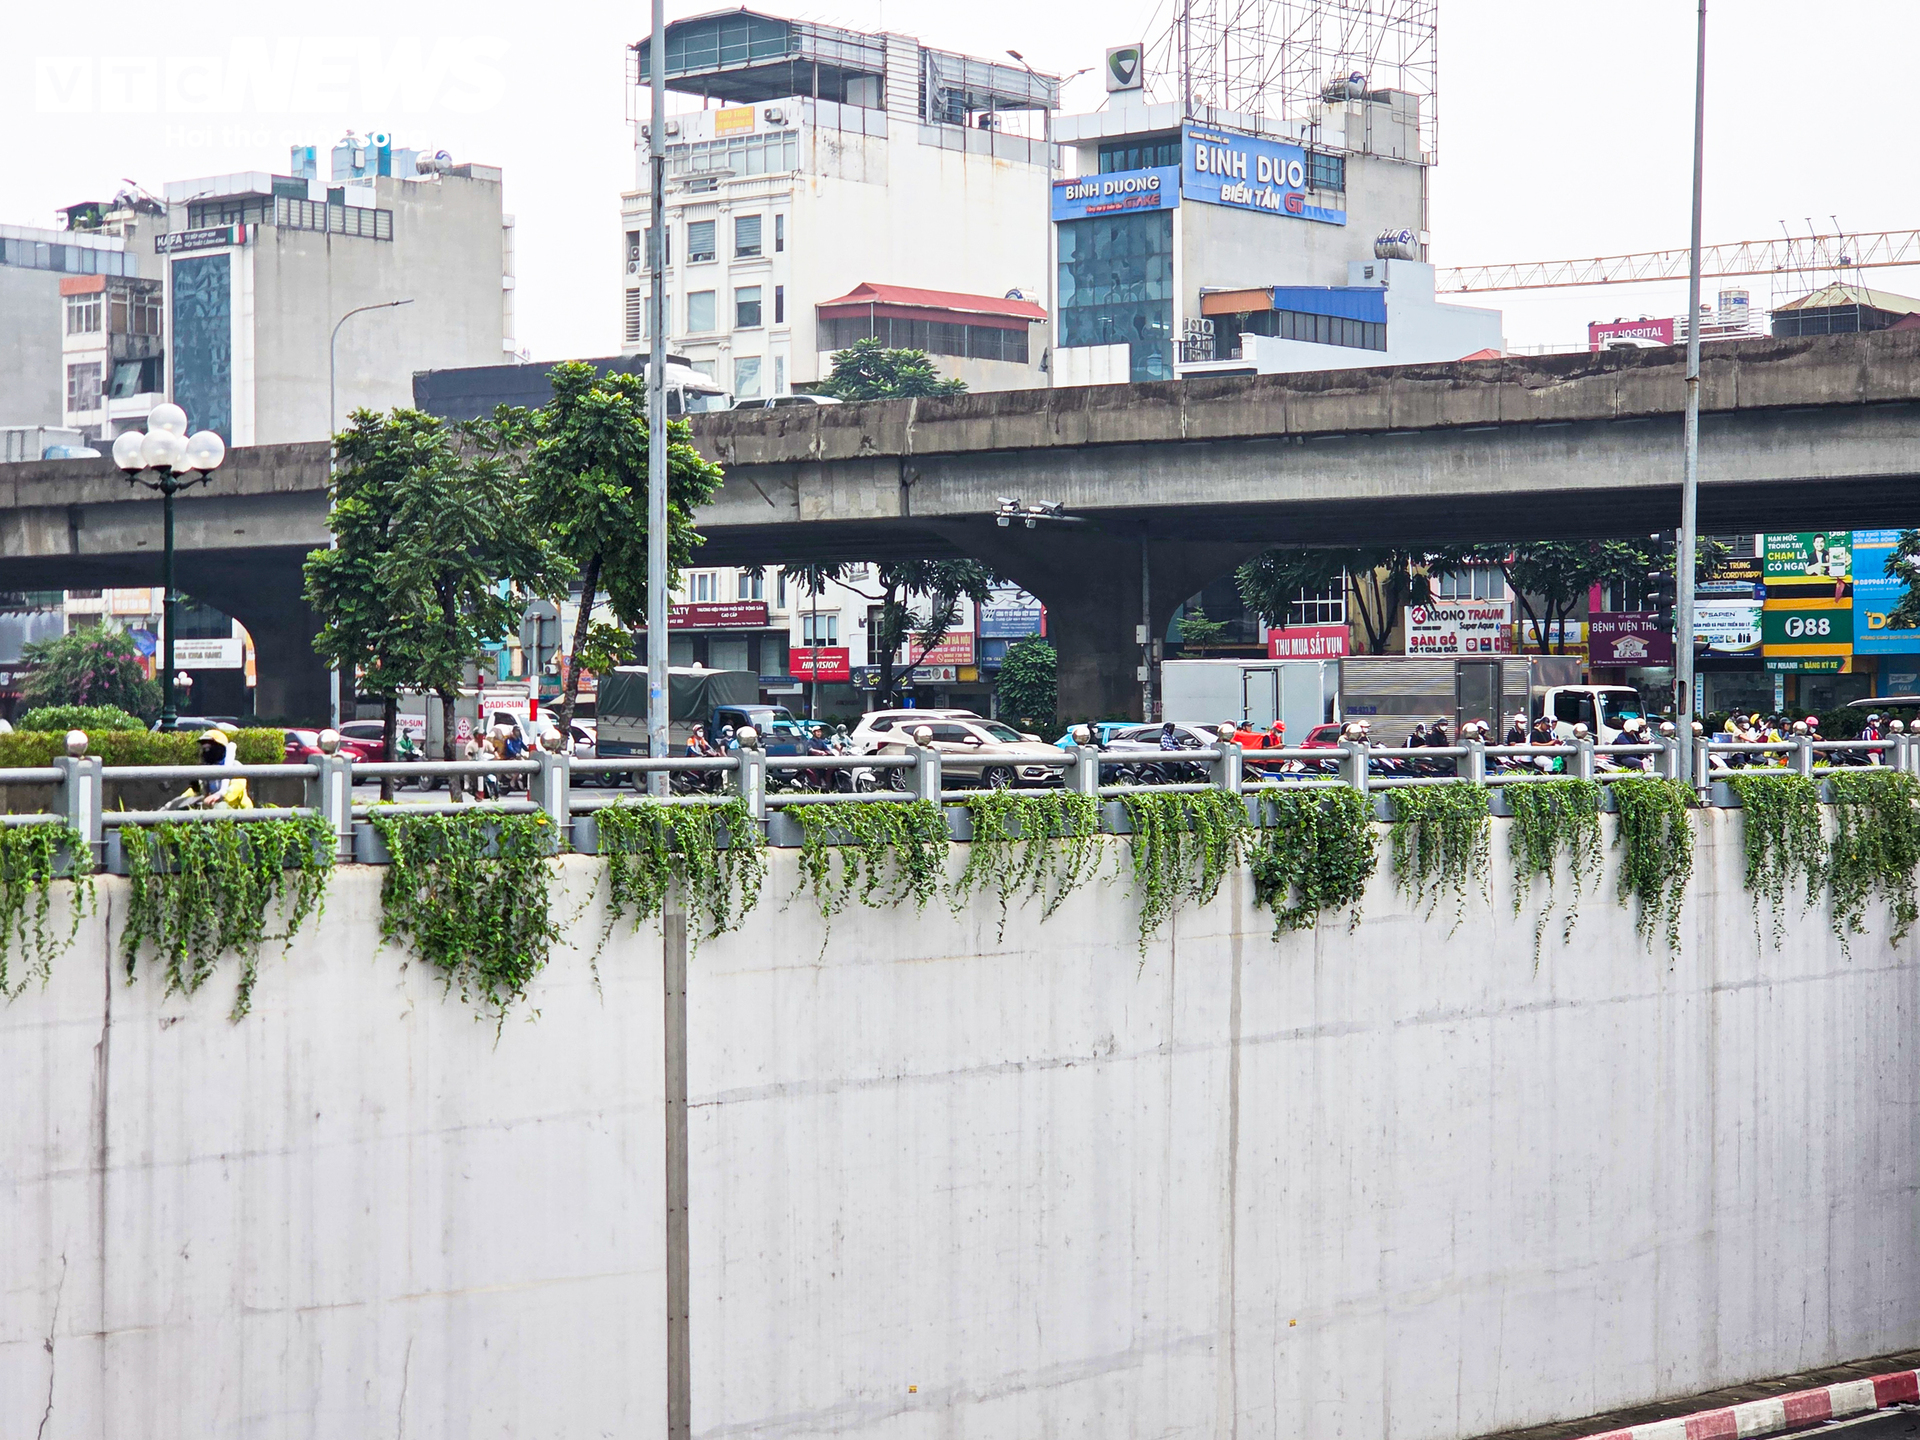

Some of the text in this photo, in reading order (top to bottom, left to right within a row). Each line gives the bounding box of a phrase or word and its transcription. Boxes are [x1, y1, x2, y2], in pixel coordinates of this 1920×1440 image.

[1195, 143, 1247, 179] BINH
[1065, 175, 1160, 200] BINH DUONG
[1618, 326, 1663, 339] HOSPITAL
[1768, 549, 1808, 562] CHẠM LÀ
[1768, 561, 1809, 571] CÓ NGAY
[1427, 609, 1504, 621] KRONO TRAUM
[1459, 621, 1494, 631] Super Aqua
[1592, 620, 1615, 634] BỆNH
[1618, 619, 1638, 633] VIỆN
[1785, 616, 1831, 637] F88
[1275, 631, 1343, 658] THU MUA SẮT VỤN
[1411, 632, 1457, 646] SÀN GỖ
[484, 701, 524, 709] CADI-SUN
[396, 718, 423, 727] ADI-SUN
